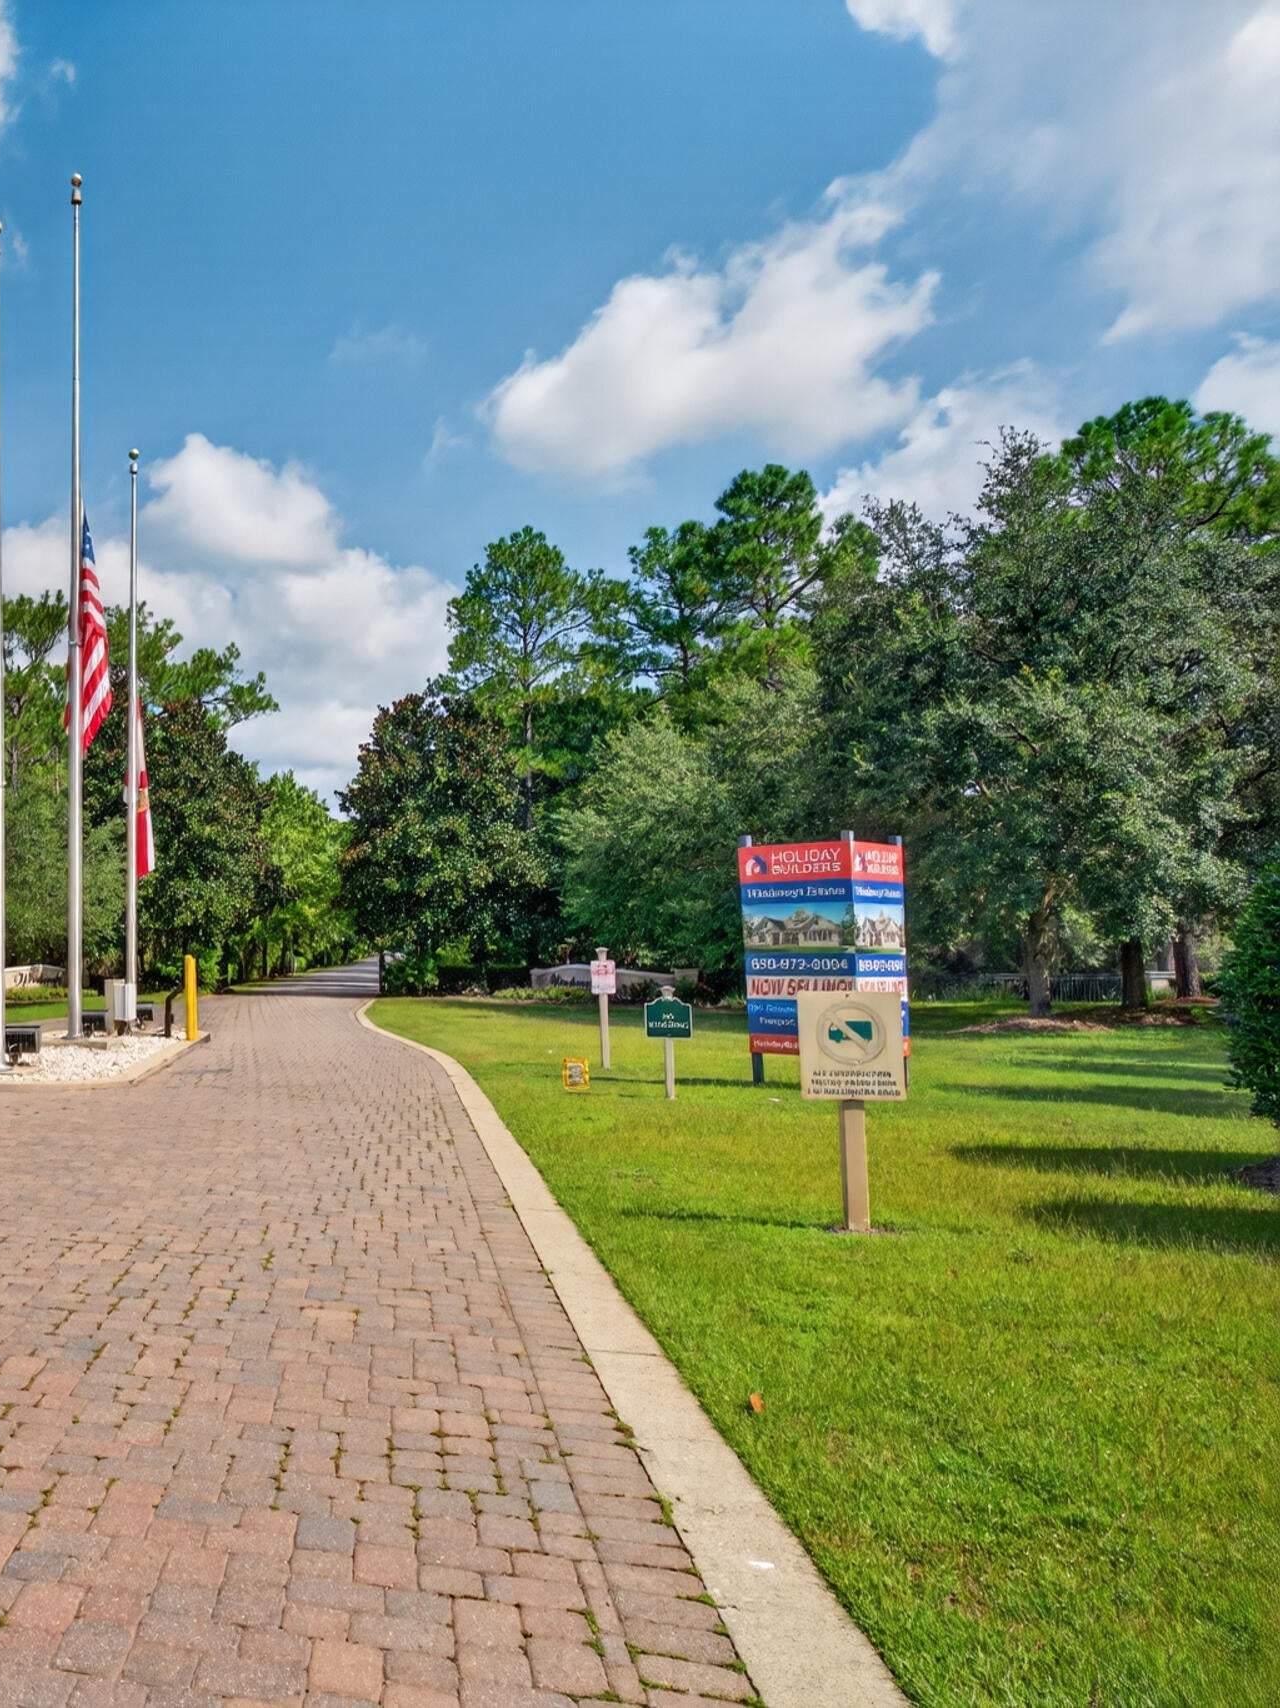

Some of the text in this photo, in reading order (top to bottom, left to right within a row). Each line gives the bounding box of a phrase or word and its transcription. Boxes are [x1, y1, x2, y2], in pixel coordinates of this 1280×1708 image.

[771, 848, 841, 864] HOLIDAY
[771, 862, 841, 875] BUILDERS
[751, 979, 785, 995] NOW
